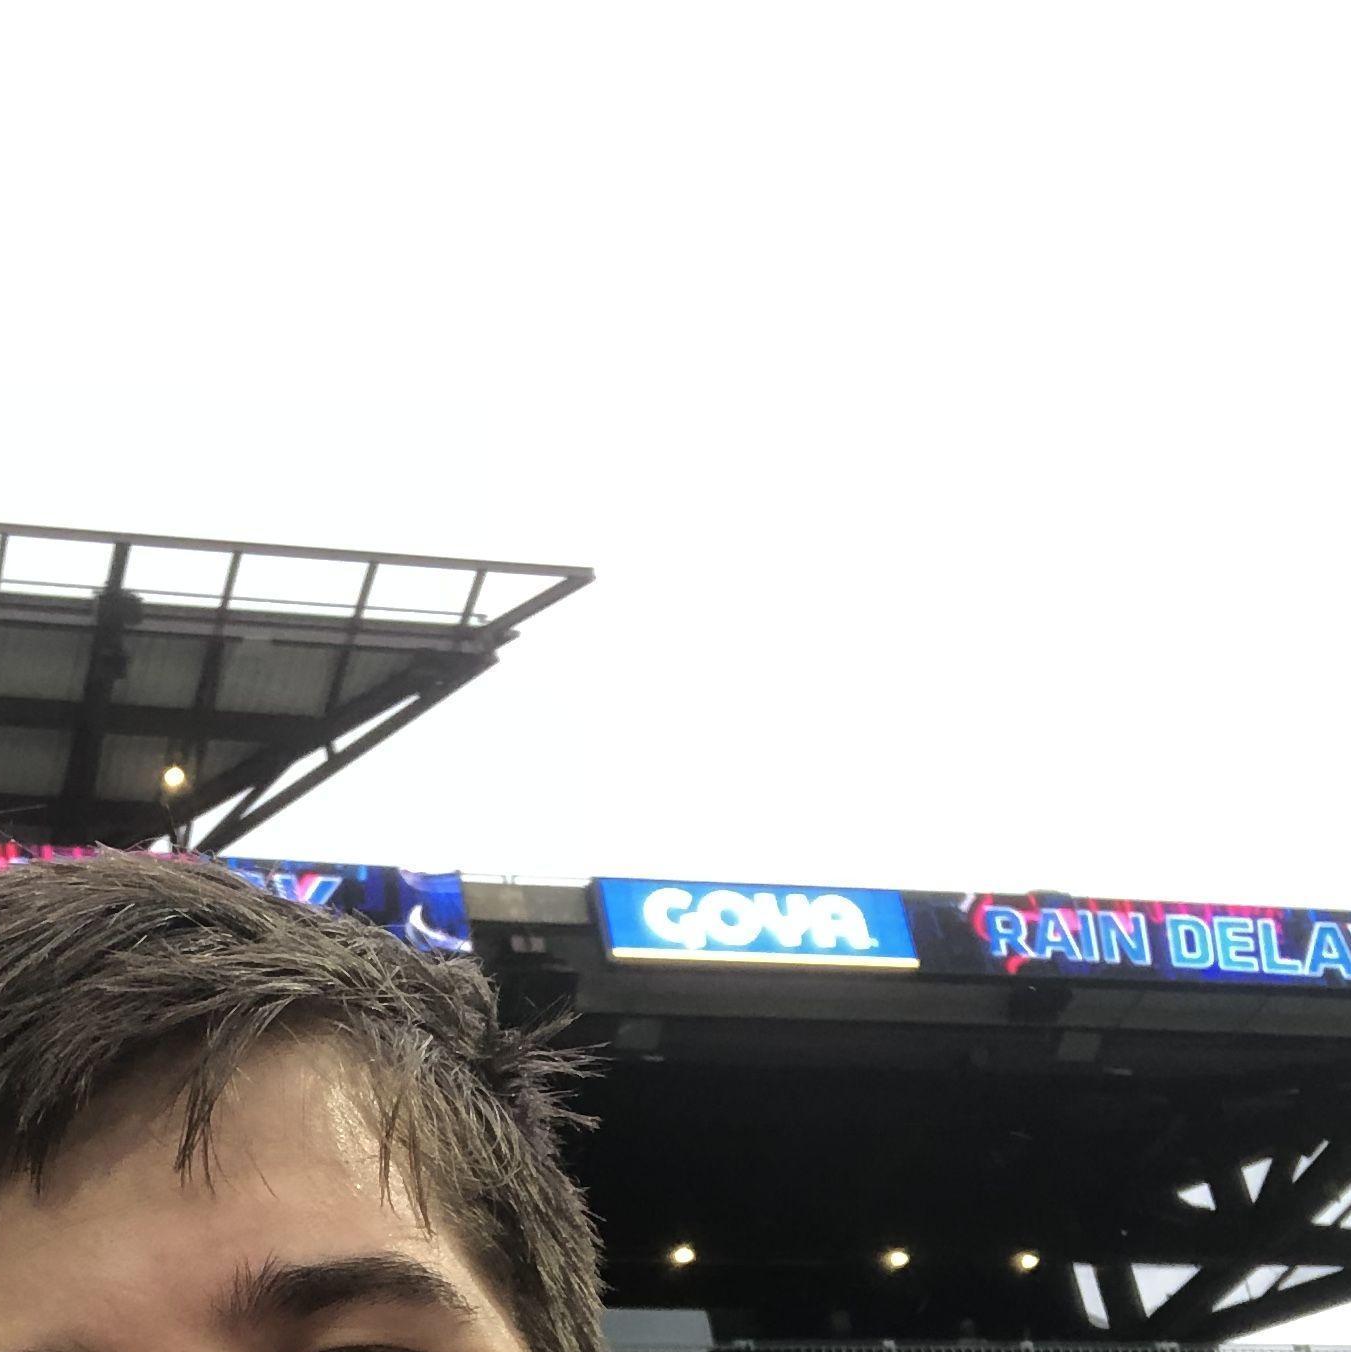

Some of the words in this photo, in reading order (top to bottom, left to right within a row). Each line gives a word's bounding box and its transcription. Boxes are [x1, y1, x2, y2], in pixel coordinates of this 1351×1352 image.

[643, 887, 871, 950] GOYA
[984, 904, 1152, 966] RAIN
[1165, 913, 1351, 980] DELA
